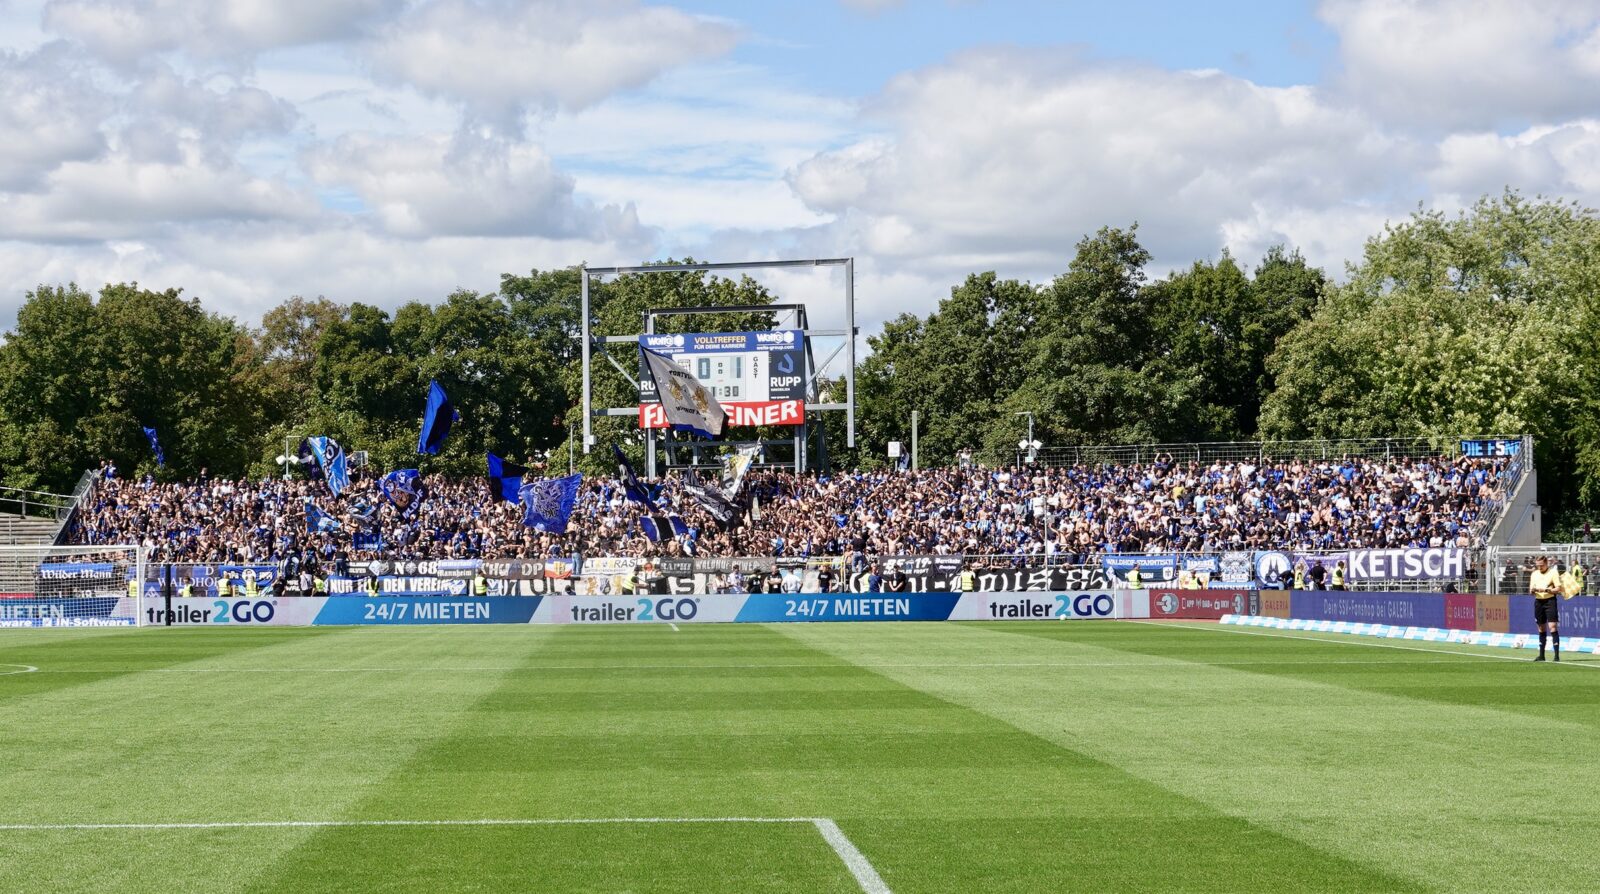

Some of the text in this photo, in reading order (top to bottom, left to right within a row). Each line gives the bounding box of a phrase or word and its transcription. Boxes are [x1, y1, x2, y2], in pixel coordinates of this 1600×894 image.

[694, 335, 746, 344] VOLLTREFFER
[770, 376, 802, 387] RUPP
[1349, 549, 1463, 578] KETSCH
[41, 569, 112, 579] Wilder Mann
[331, 578, 353, 593] NUR
[384, 578, 406, 592] DEN
[0, 604, 64, 619] IETEN
[364, 602, 490, 620] 24/7 MIETEN
[571, 598, 698, 621] trailer2GO
[785, 599, 910, 617] 24/7 MIETEN
[990, 594, 1114, 618] trailer2GO
[1324, 599, 1414, 620] Dein SSV-Fanshop bei GALERIA
[1453, 605, 1475, 620] GALERIA
